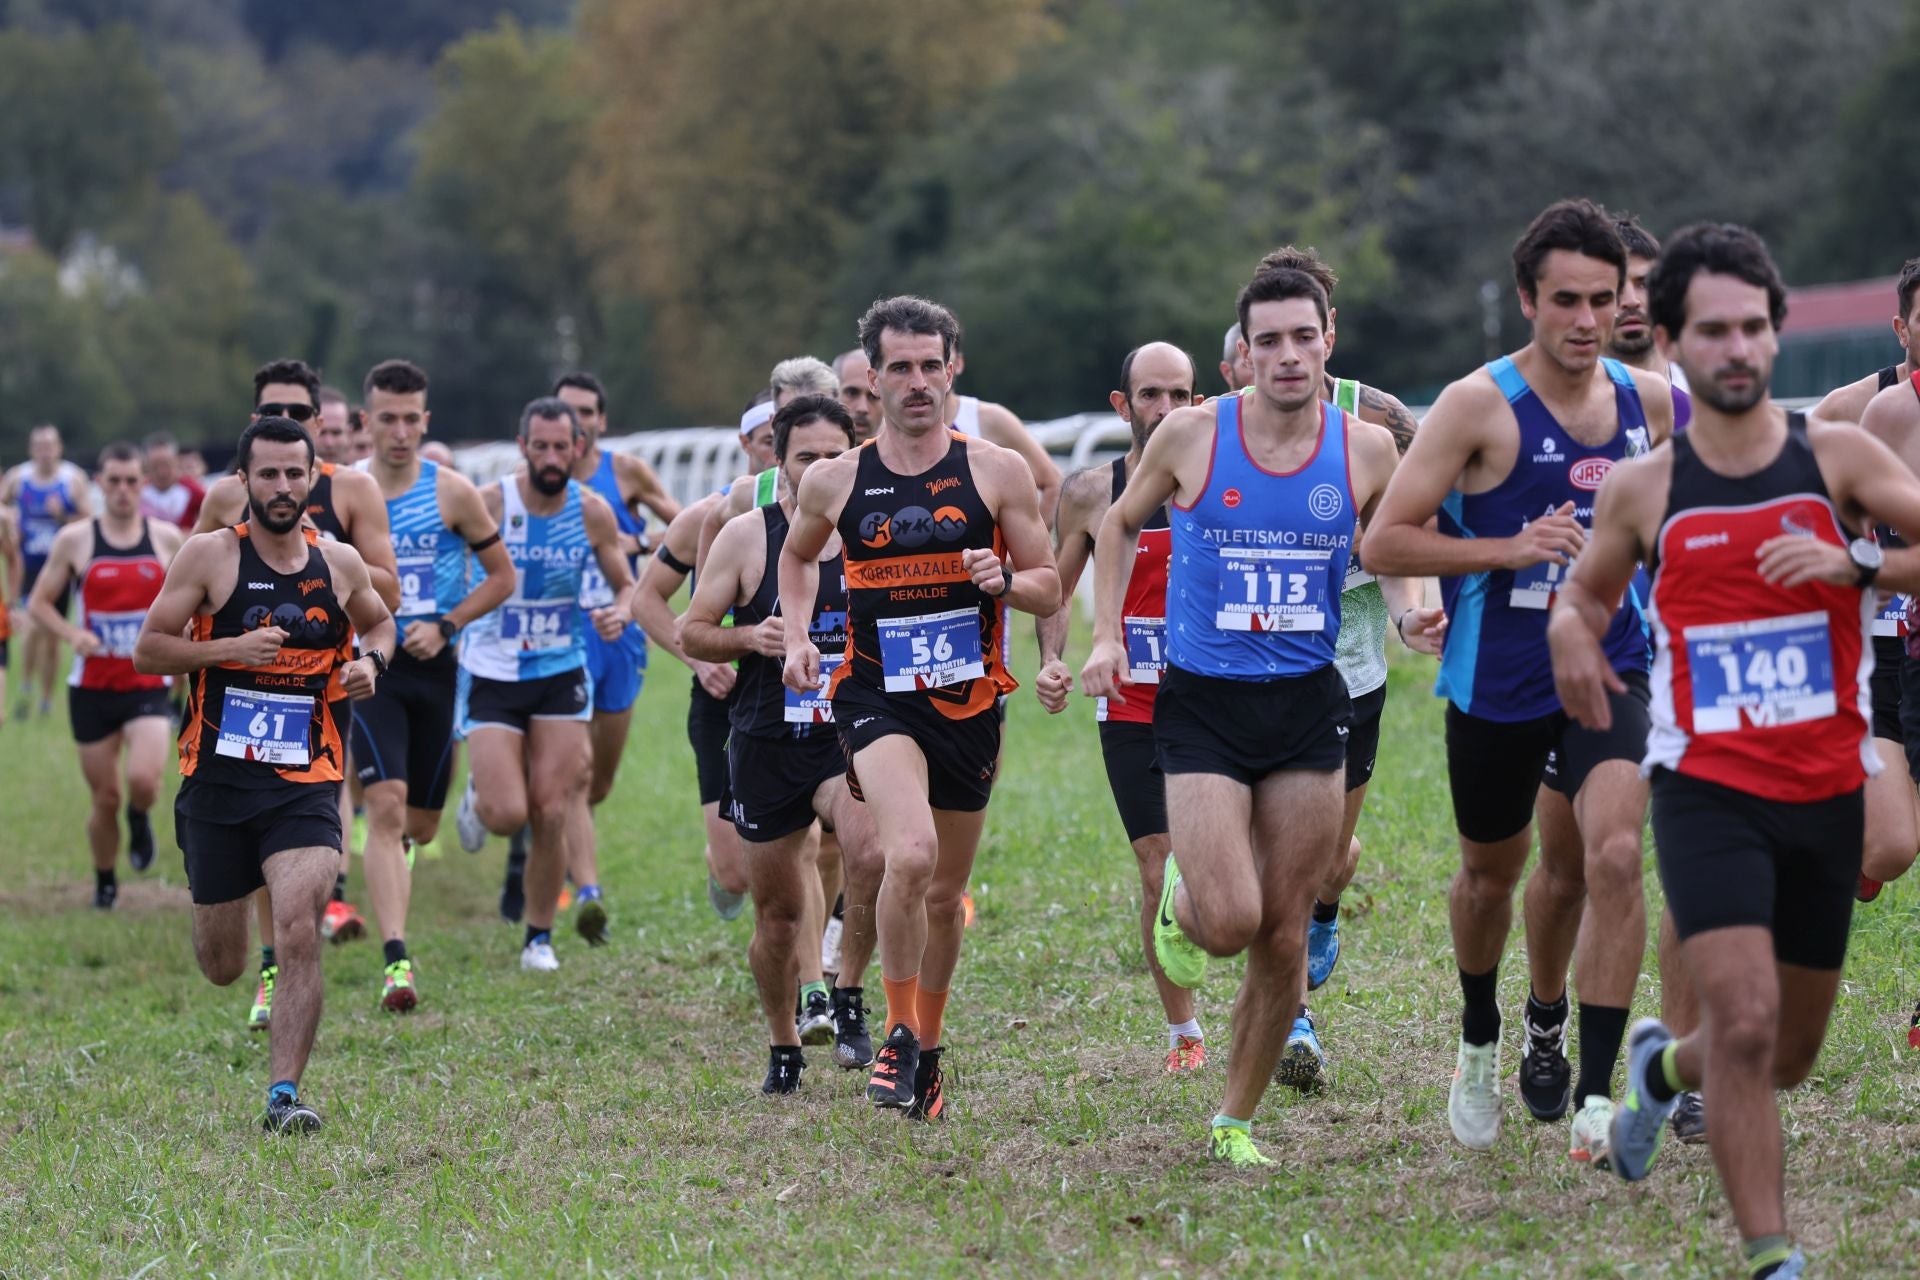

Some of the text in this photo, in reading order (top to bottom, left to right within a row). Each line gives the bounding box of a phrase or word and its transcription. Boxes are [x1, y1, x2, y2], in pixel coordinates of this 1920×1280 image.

[1533, 454, 1565, 463] VIATOR
[1203, 529, 1348, 549] ATLETISMO EIBAR
[506, 545, 565, 561] OLOSA
[860, 560, 967, 580] KORRIKAZALEA
[890, 587, 948, 601] REKALDE
[1244, 572, 1308, 604] 113
[1529, 582, 1552, 591] JON
[1224, 603, 1265, 613] MARKEL
[1884, 611, 1908, 620] AGU
[519, 612, 560, 635] 184
[911, 633, 953, 665] 56
[933, 657, 966, 673] MARTIN
[1718, 645, 1808, 693] 140
[255, 675, 305, 687] REKALDE
[248, 711, 285, 740] 61
[223, 732, 260, 746] YOUSSEF
